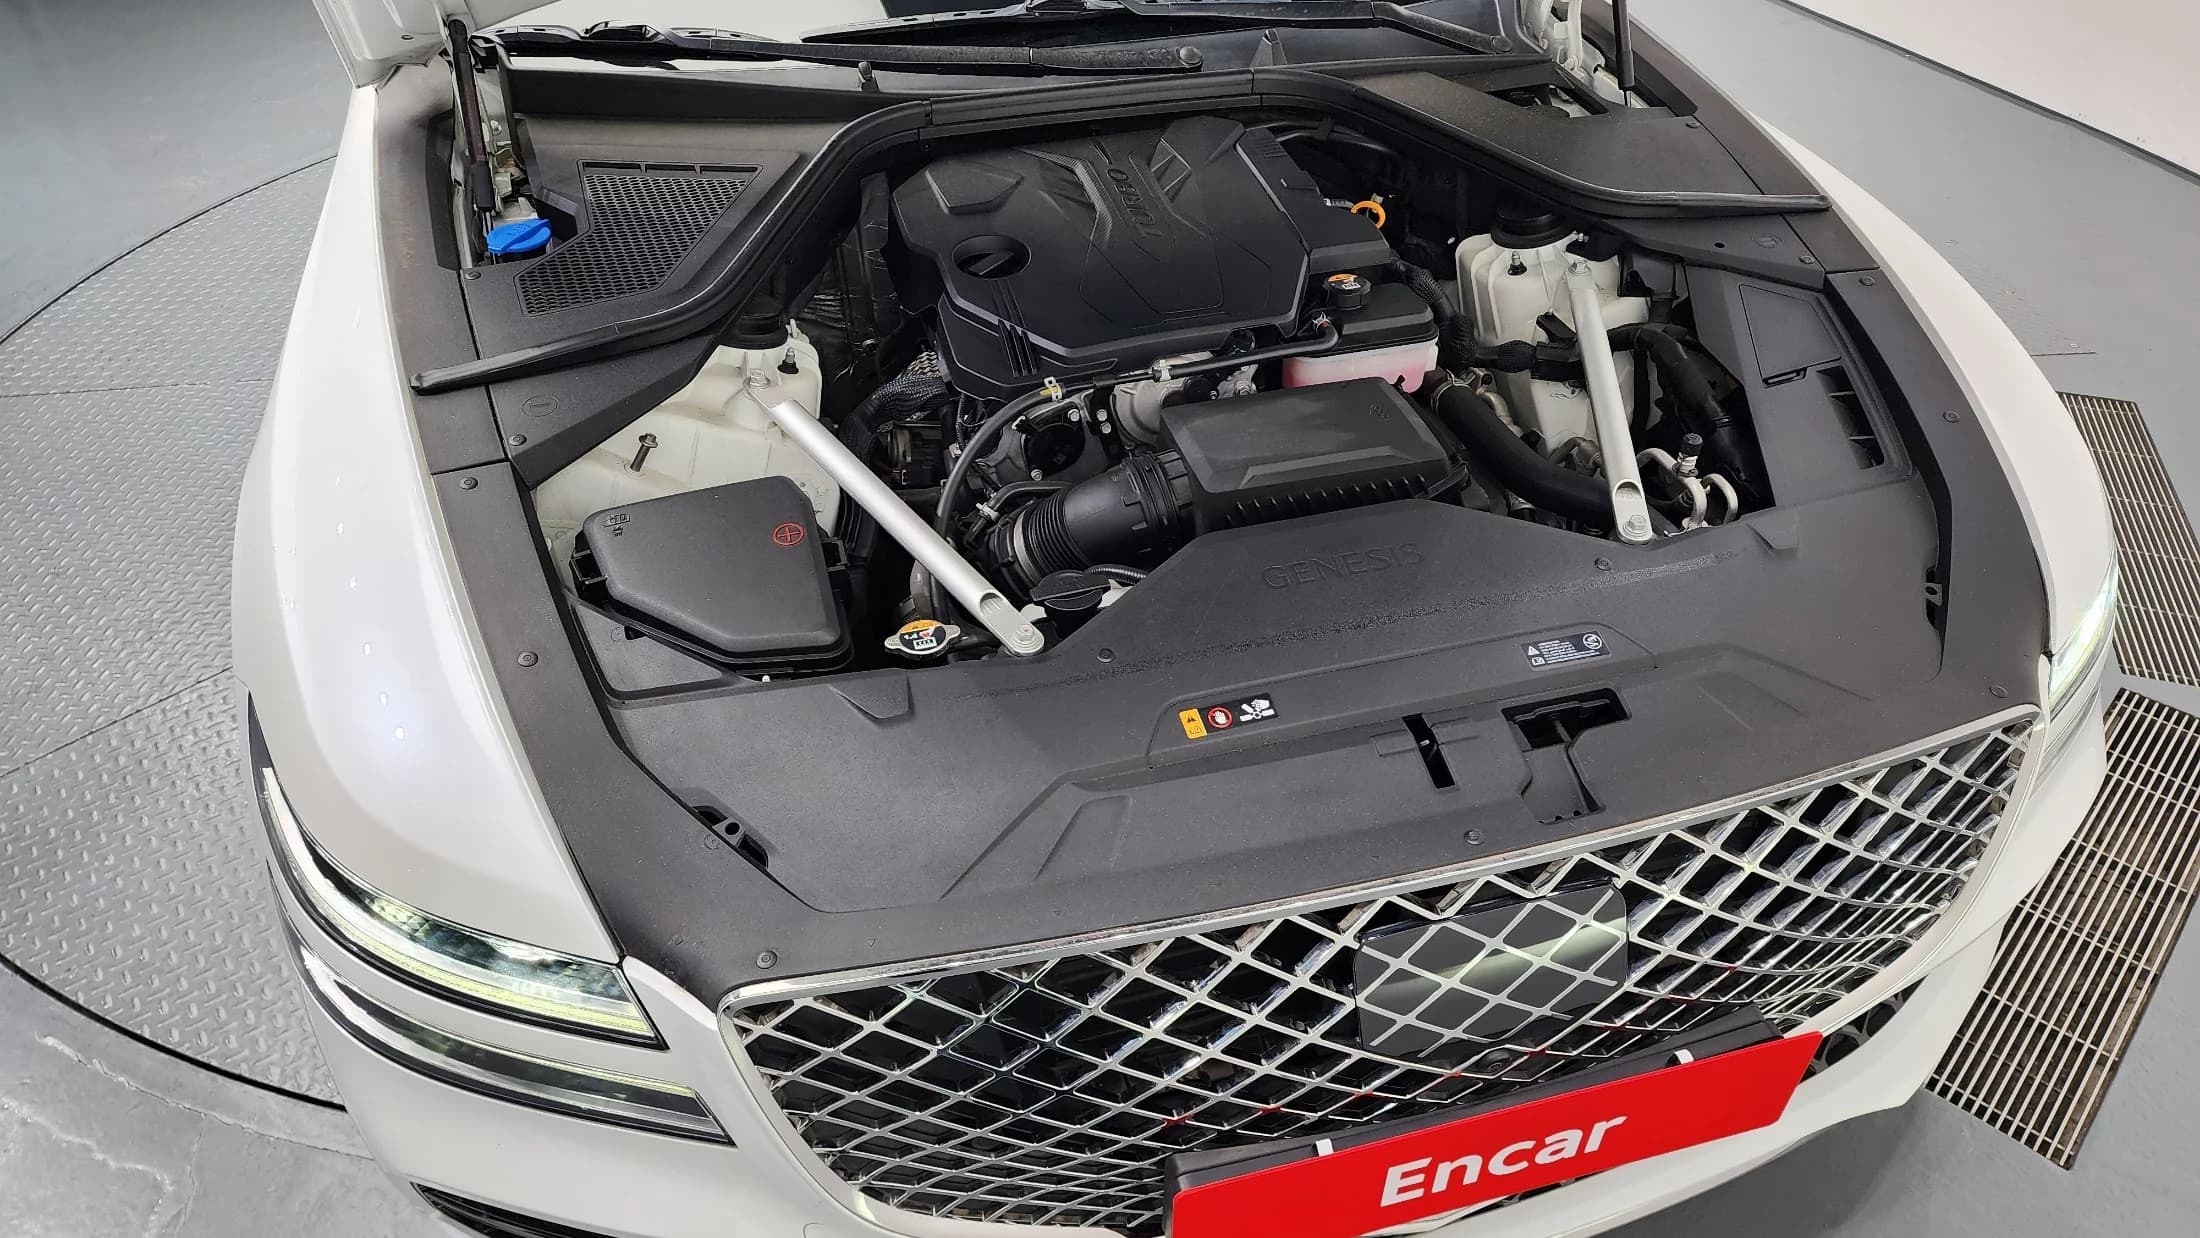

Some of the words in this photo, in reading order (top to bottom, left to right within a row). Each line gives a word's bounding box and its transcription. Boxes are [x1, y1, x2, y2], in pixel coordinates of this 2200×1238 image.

[1106, 168, 1164, 239] TURBO
[1263, 543, 1423, 588] GENESIS
[1380, 1115, 1628, 1208] Encar
